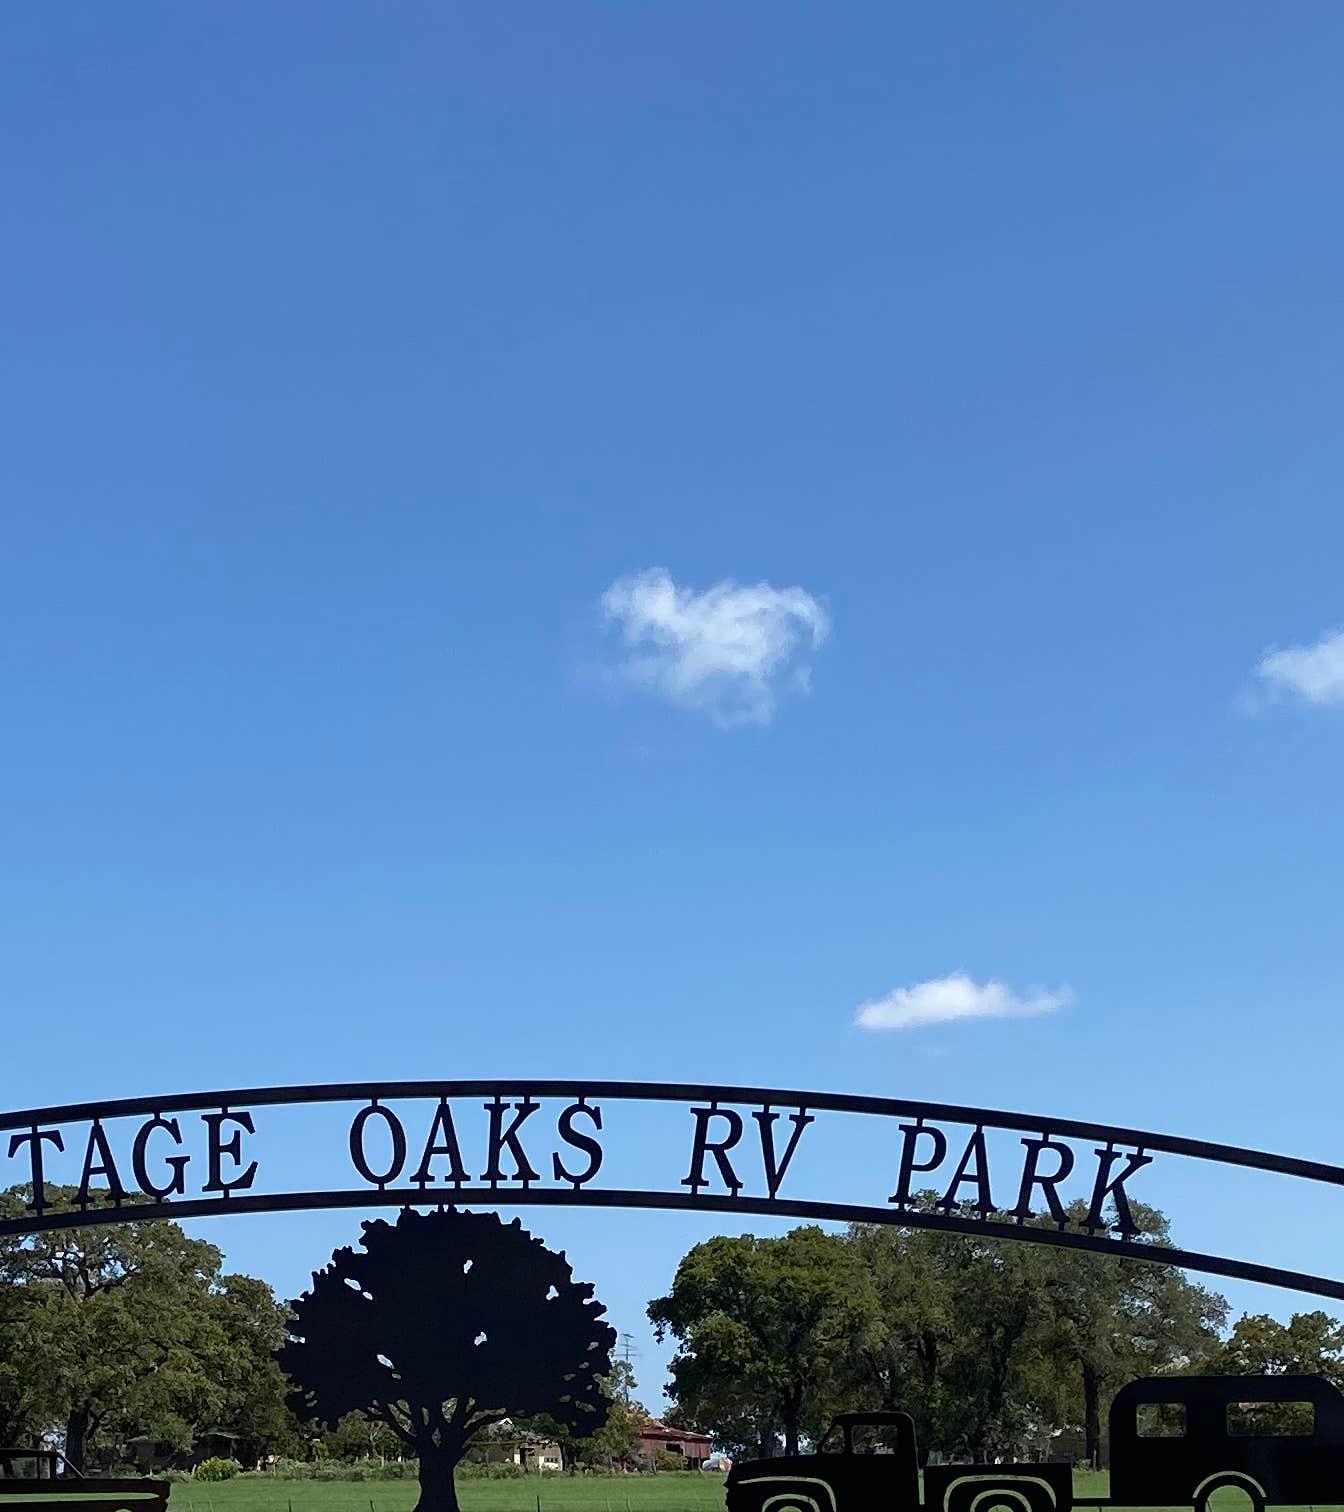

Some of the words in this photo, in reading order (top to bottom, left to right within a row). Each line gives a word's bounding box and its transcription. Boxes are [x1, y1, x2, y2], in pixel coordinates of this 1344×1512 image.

[349, 1102, 603, 1185] OAKS
[681, 1107, 815, 1196] RV
[887, 1124, 1153, 1235] PARK
